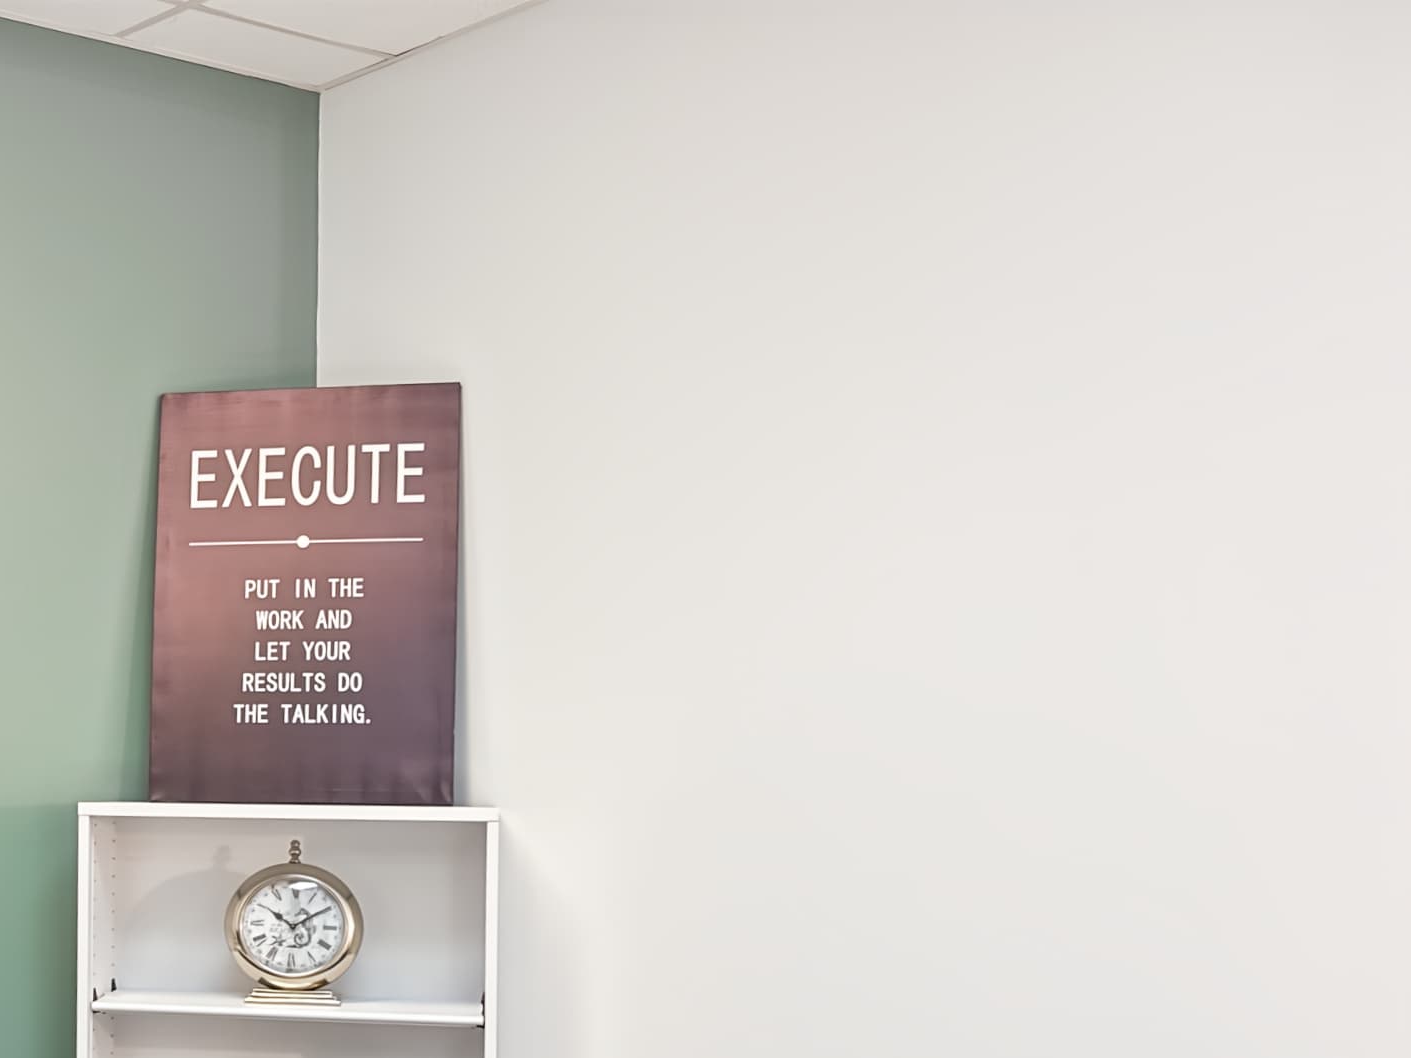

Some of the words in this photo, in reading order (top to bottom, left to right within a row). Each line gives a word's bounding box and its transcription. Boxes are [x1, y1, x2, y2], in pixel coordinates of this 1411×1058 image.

[189, 442, 426, 509] EXECUTE
[244, 578, 281, 599] PUT
[295, 578, 317, 599] IN
[328, 577, 365, 598] THE
[255, 610, 305, 631] WORK
[315, 609, 353, 630] AND
[254, 641, 291, 661] LET
[302, 640, 351, 661] YOUR
[242, 672, 326, 693] RESULTS
[337, 672, 363, 693] DO
[233, 703, 269, 724] THE
[280, 703, 372, 724] TALKING.
